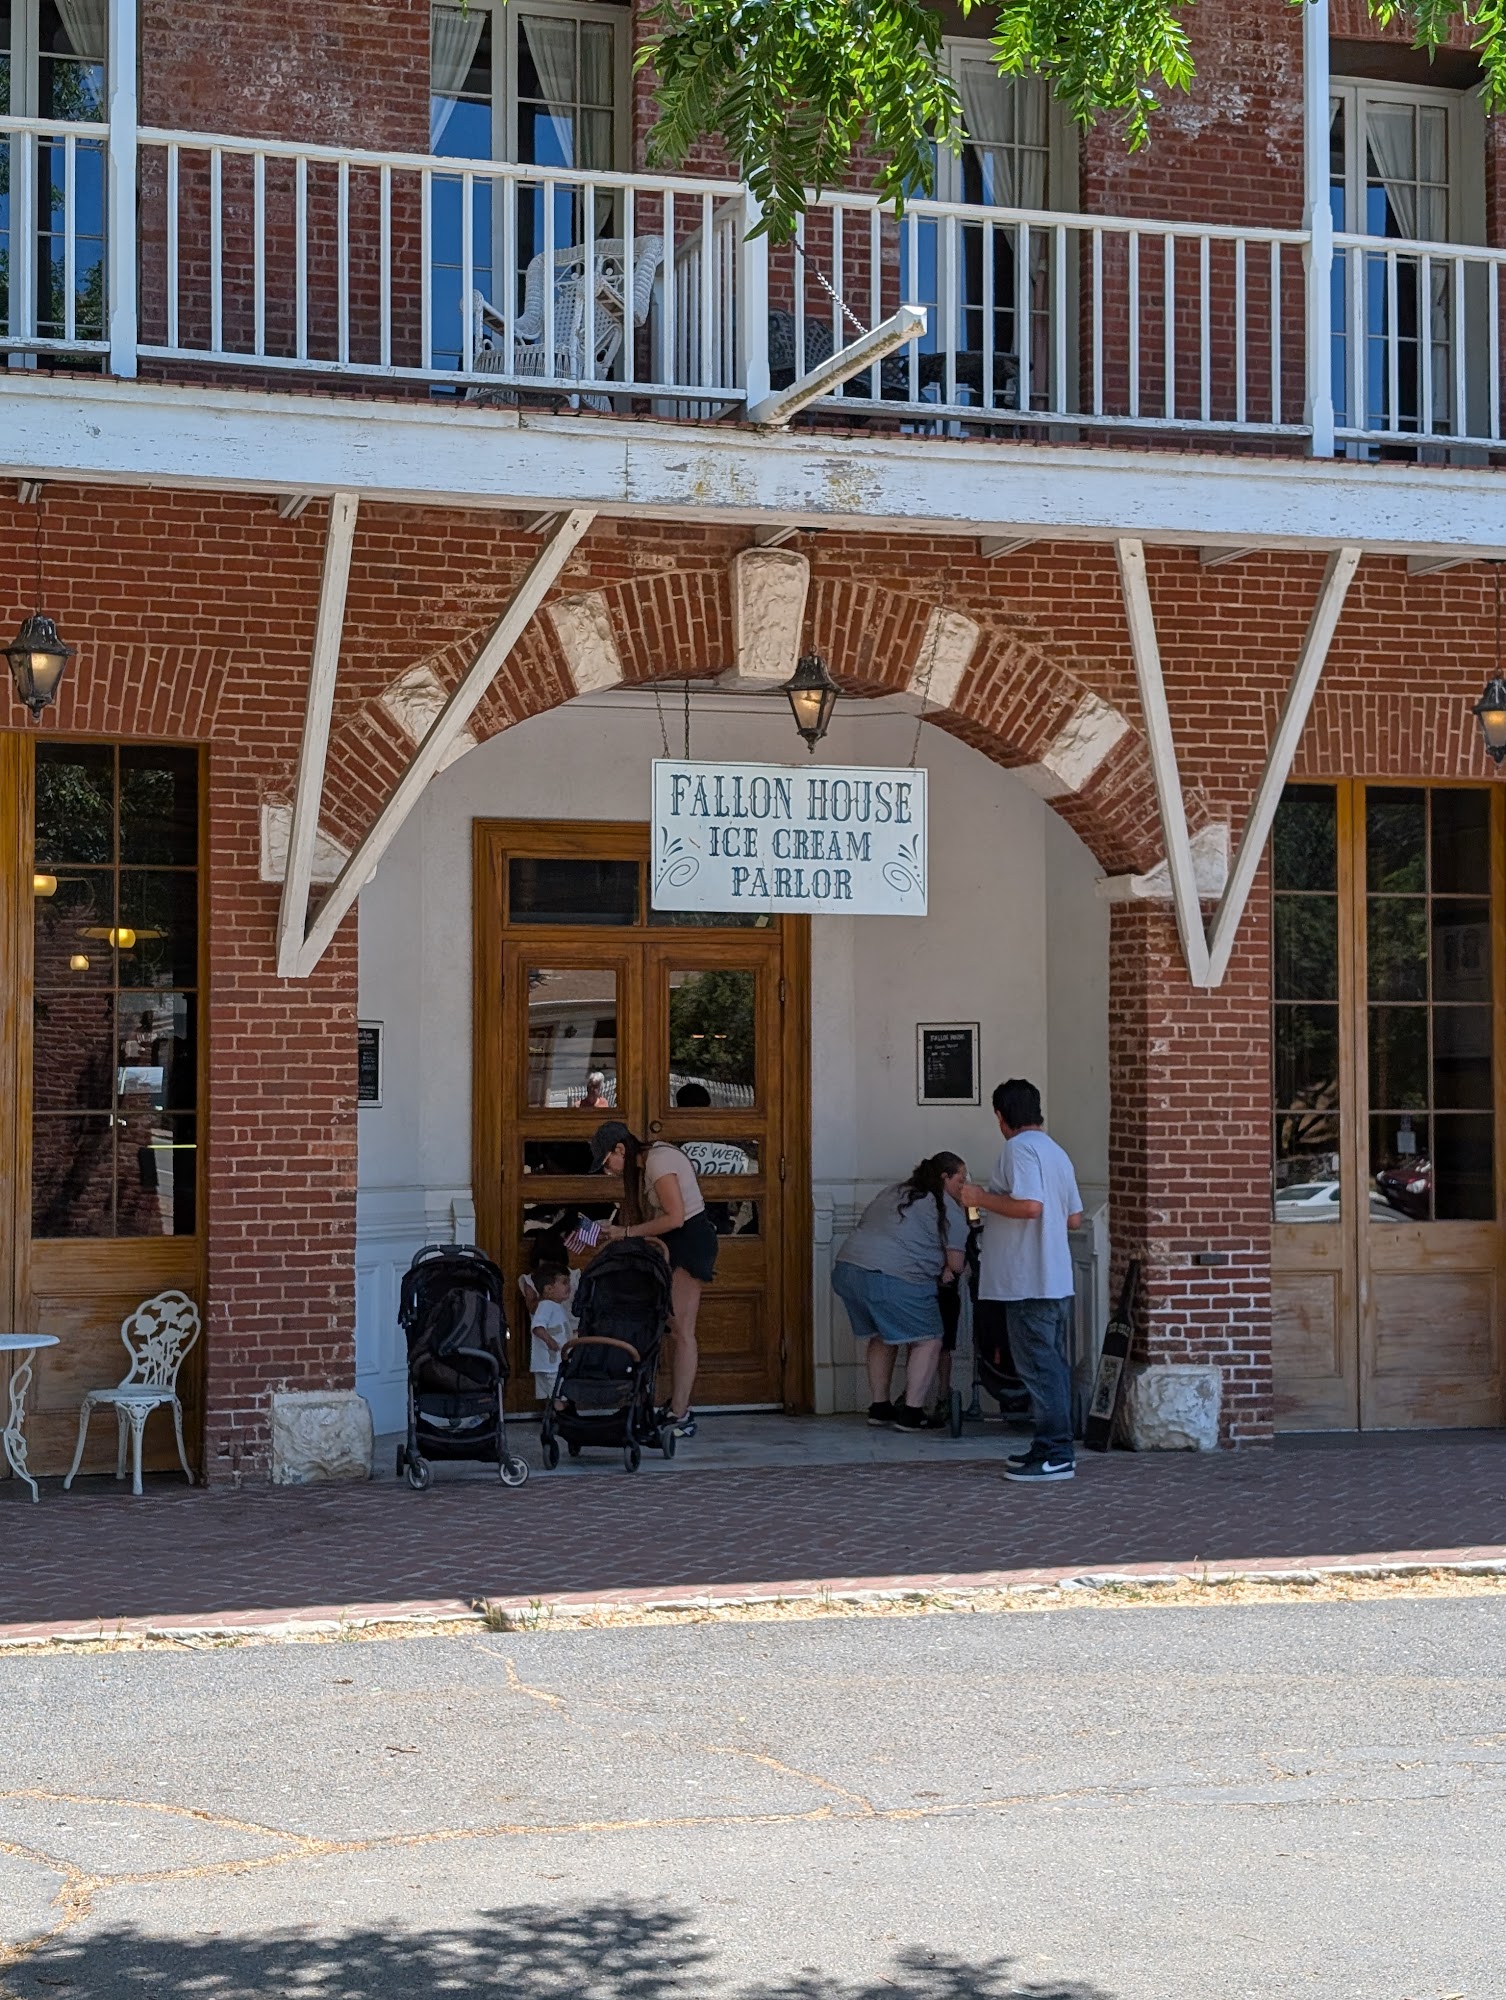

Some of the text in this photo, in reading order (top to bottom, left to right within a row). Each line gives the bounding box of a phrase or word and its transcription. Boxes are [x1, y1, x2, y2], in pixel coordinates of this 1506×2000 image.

[670, 774, 912, 824] FALLON HOUSE
[709, 826, 872, 862] ICE CREAM
[731, 866, 853, 900] PARLOR
